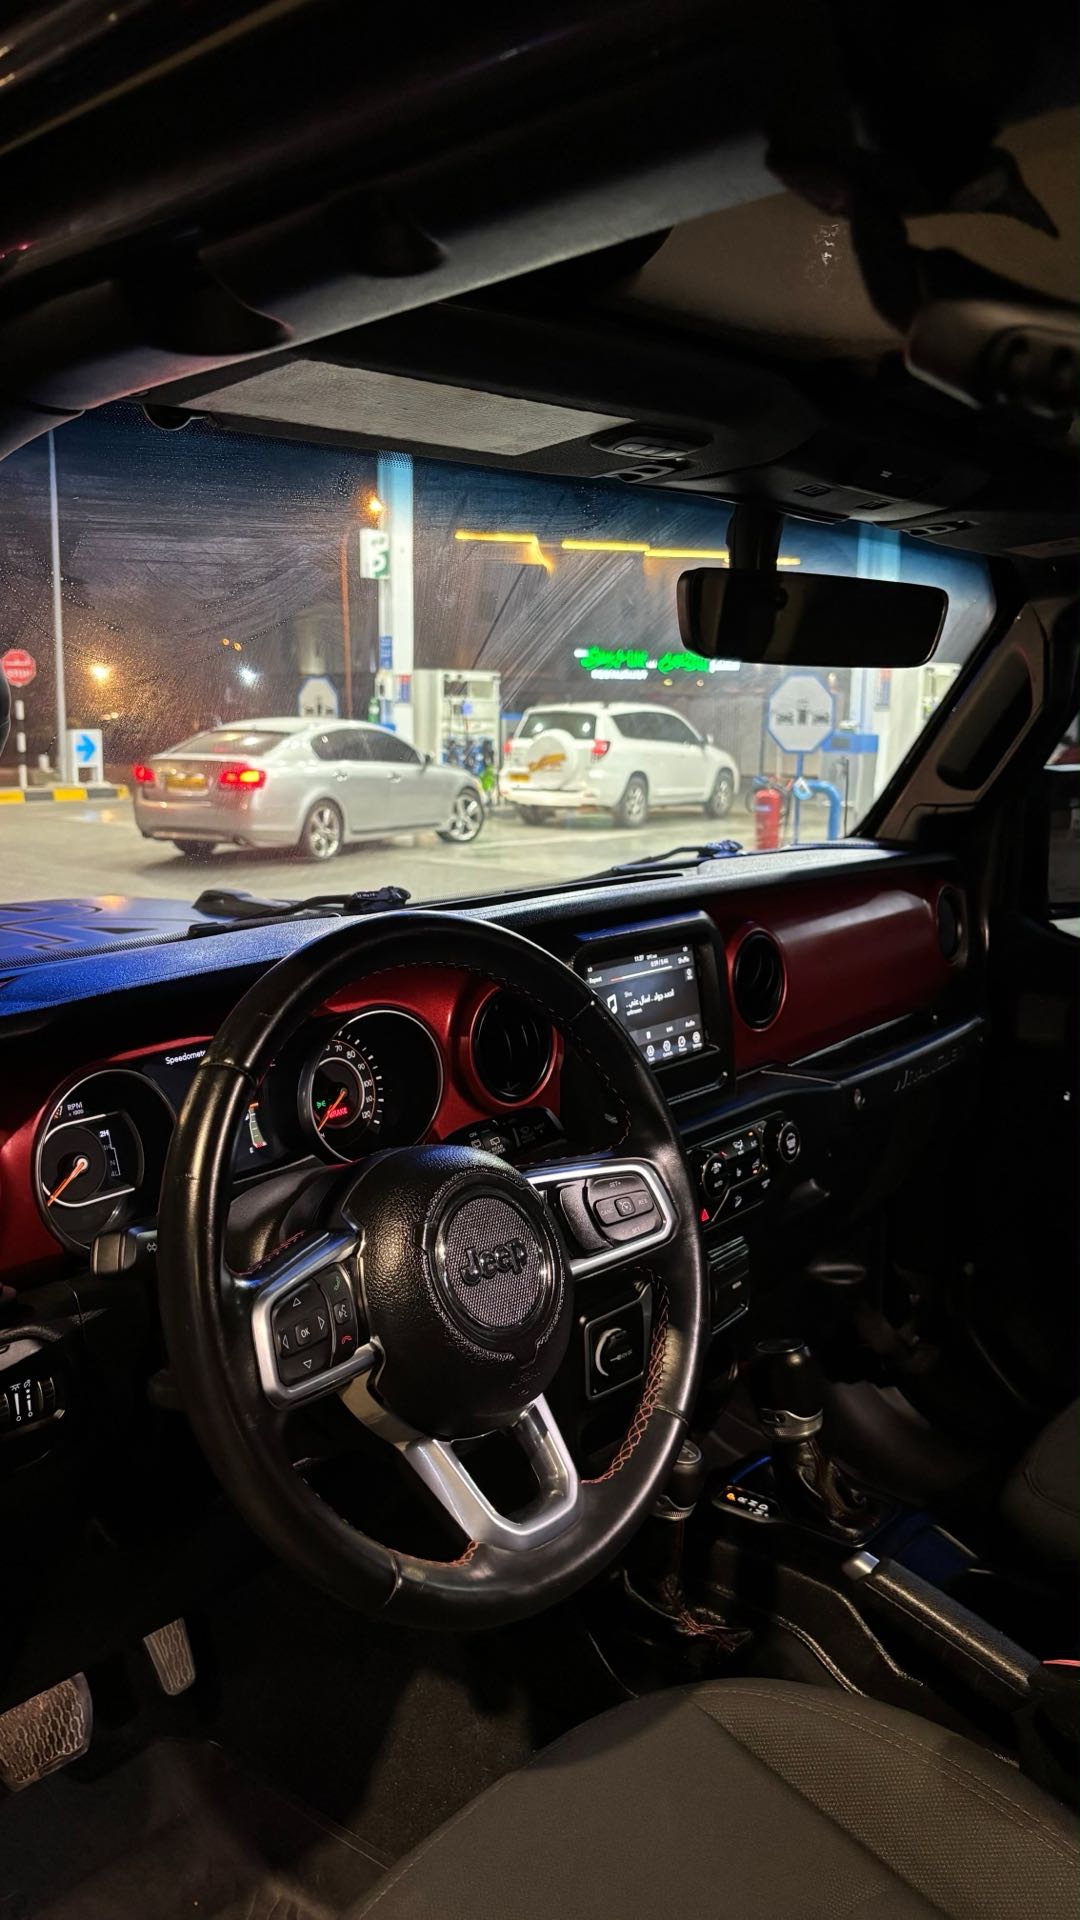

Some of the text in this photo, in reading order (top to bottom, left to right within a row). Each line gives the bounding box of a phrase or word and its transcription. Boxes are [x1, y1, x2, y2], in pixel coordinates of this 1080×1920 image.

[334, 1044, 343, 1052] 70
[346, 1050, 356, 1059] 80
[67, 1102, 83, 1111] RPM
[361, 1110, 371, 1119] 120
[99, 1129, 110, 1138] 2H
[461, 1238, 528, 1286] Jeep
[300, 1328, 310, 1338] OK
[726, 1492, 768, 1512] P R N D
